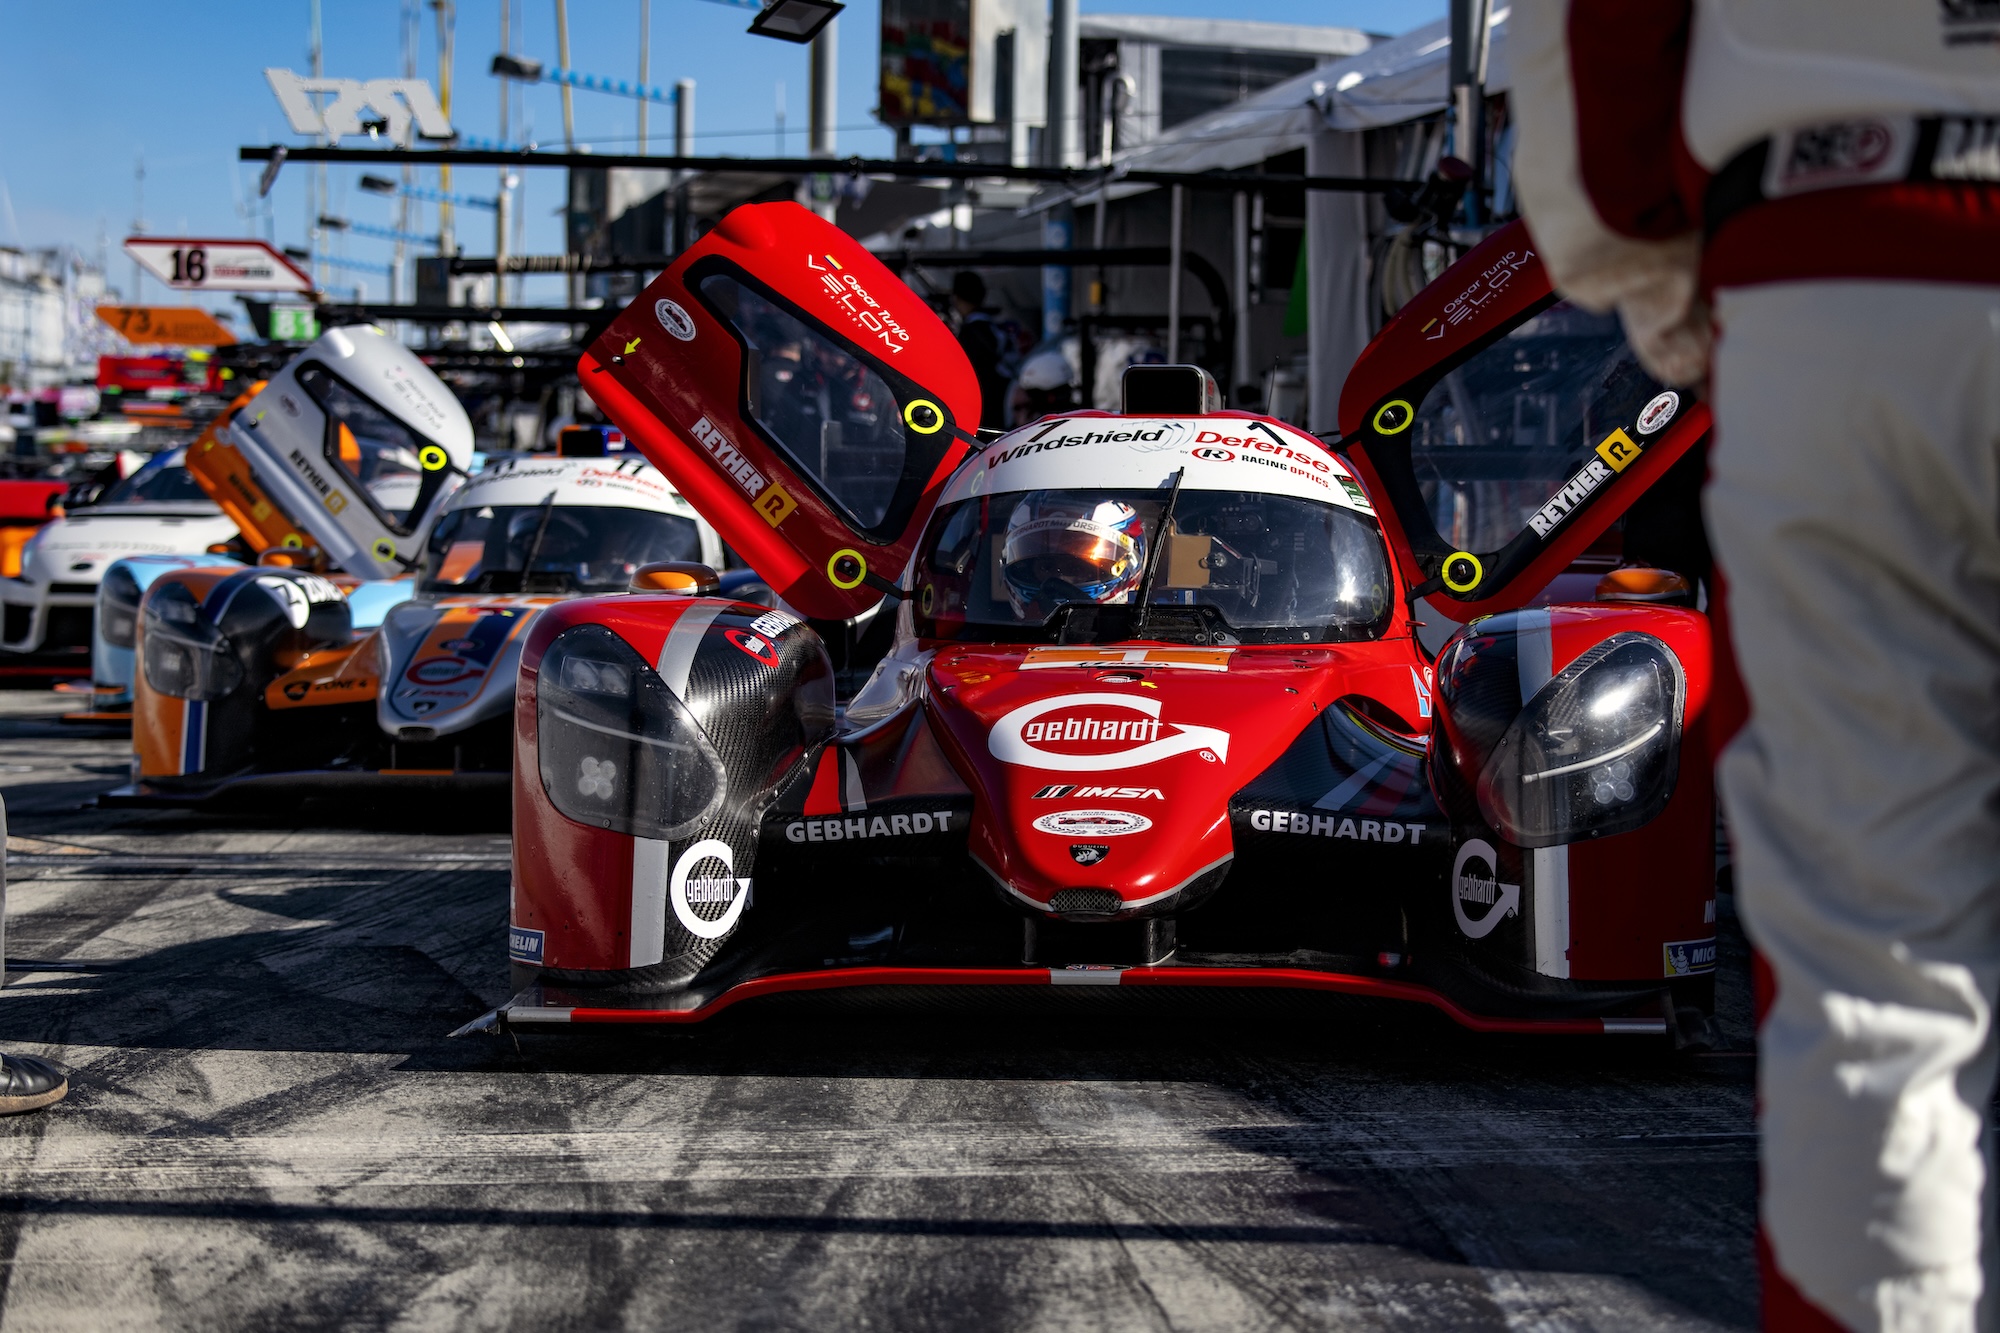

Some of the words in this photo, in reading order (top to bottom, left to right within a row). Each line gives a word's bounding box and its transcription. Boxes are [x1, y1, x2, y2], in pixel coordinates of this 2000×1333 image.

[171, 249, 206, 281] 16
[1443, 280, 1480, 313] Oscar
[1481, 251, 1516, 279] Tunjo
[117, 308, 152, 332] 73
[808, 254, 903, 354] VELOM
[843, 275, 880, 308] Oscar
[878, 310, 910, 341] Tunjo
[691, 417, 765, 498] REYHER
[988, 430, 1165, 469] Windshield
[1195, 431, 1330, 473] Defense
[1241, 455, 1287, 471] RACING
[1290, 466, 1330, 488] OPTICS
[1529, 460, 1612, 537] REYHER
[1026, 717, 1163, 743] gebhardt
[1073, 786, 1165, 800] IMSA
[785, 811, 953, 843] GEBHARDT
[1250, 810, 1427, 845] GEBHARDT
[686, 874, 734, 903] gebhardt
[1459, 873, 1496, 905] gebhardt
